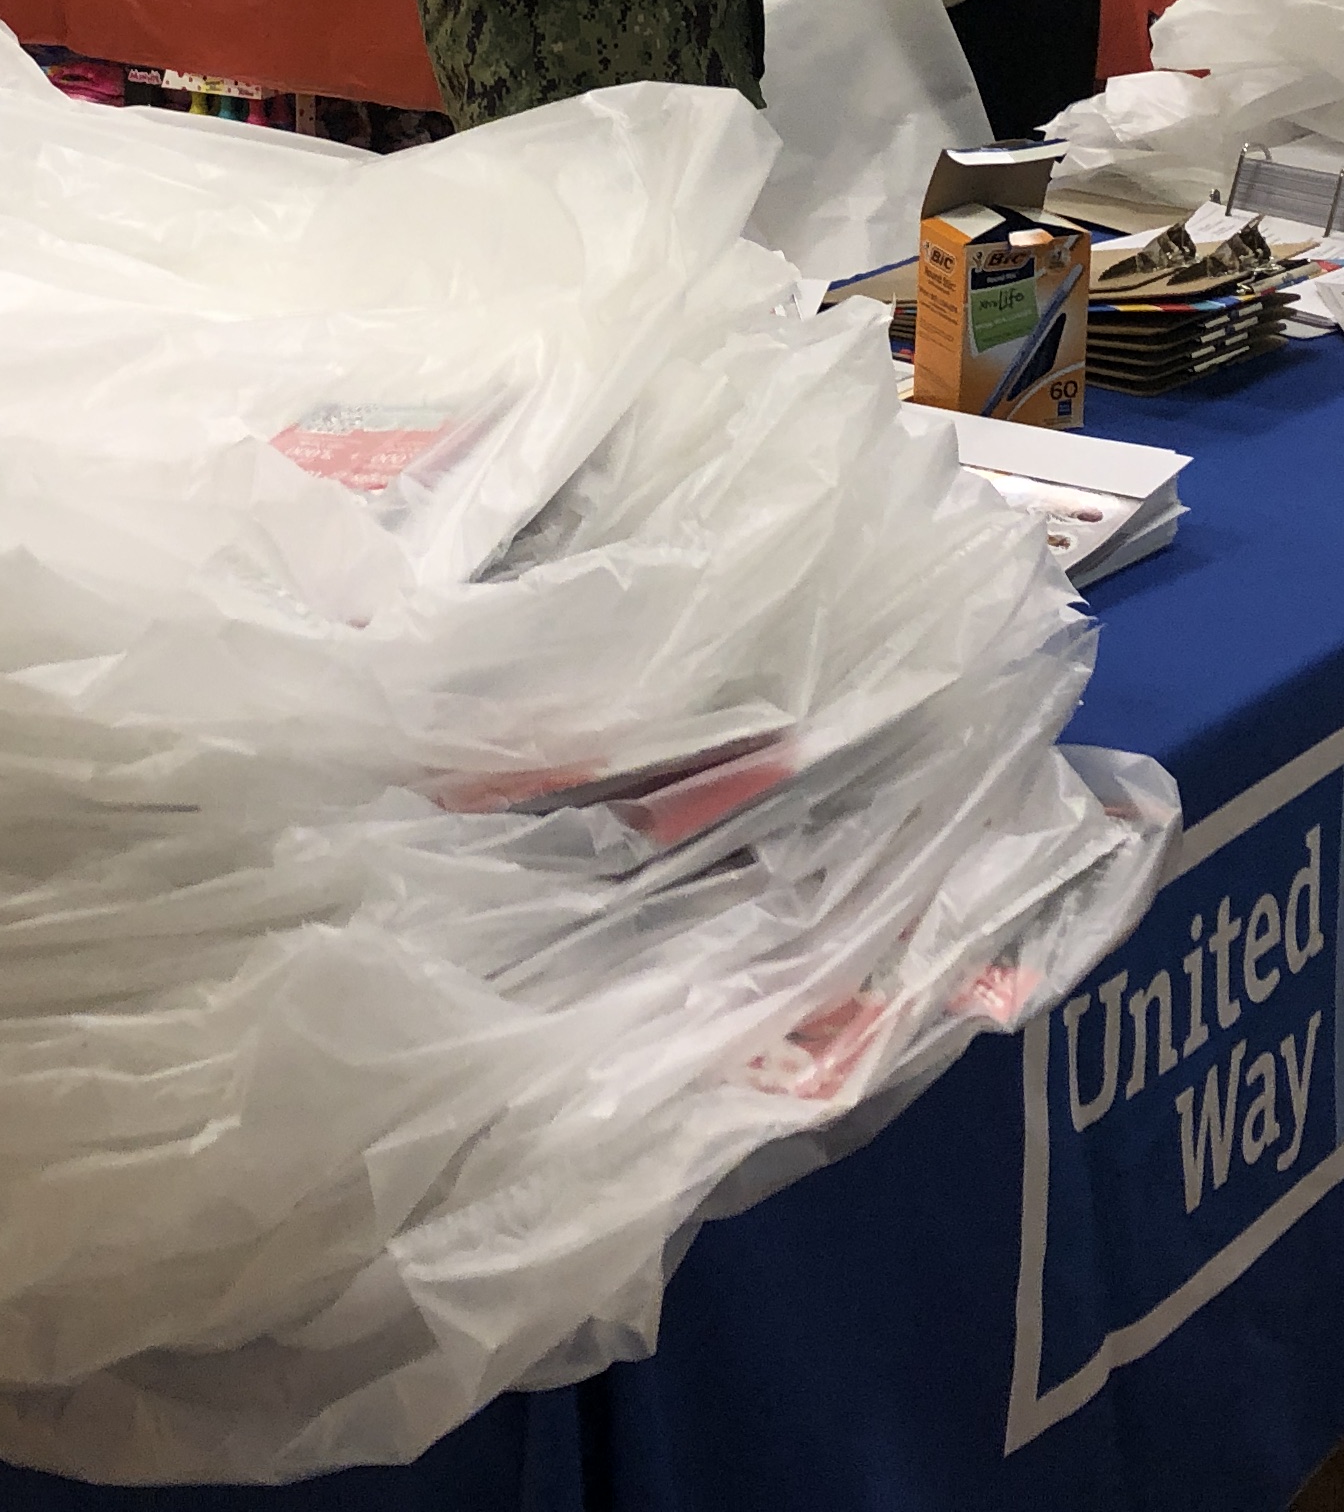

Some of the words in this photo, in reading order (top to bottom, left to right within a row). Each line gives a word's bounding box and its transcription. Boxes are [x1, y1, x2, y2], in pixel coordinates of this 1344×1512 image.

[1050, 380, 1078, 400] 60
[1062, 823, 1324, 1133] United
[1175, 1010, 1323, 1215] Way
